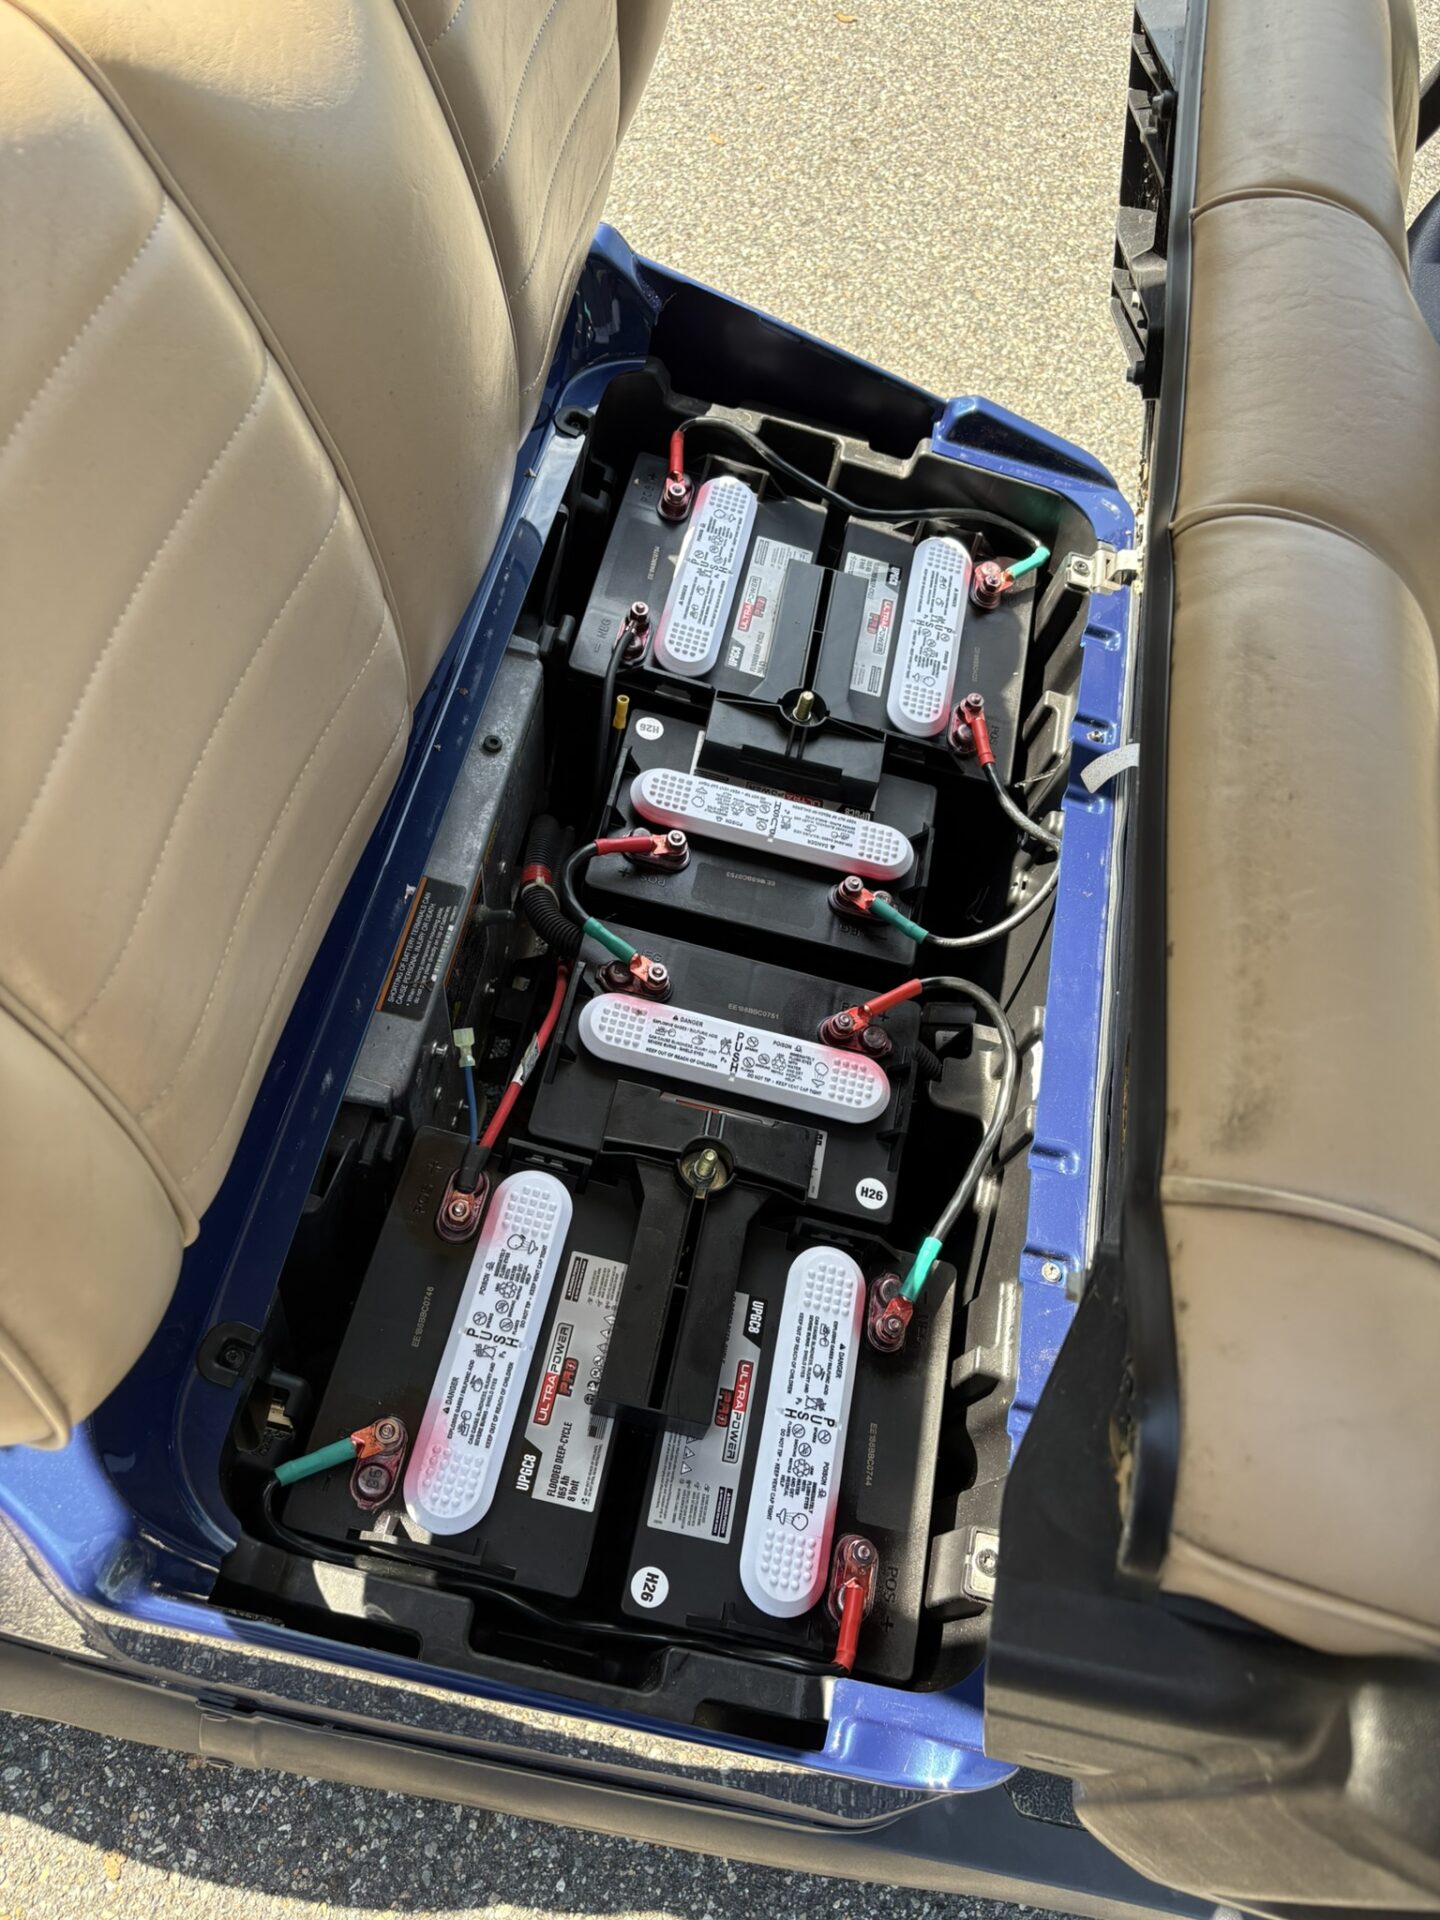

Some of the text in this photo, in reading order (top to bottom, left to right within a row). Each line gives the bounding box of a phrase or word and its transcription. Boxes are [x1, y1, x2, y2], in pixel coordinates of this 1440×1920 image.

[689, 557, 728, 574] PUSH
[915, 618, 953, 633] PUSH
[639, 722, 659, 734] H26
[768, 800, 781, 835] PUSH
[395, 901, 436, 1005] CAUSE PERSONAL INJURY OR DEATH
[679, 1015, 704, 1027] DANGER
[729, 1030, 745, 1073] PUSH
[859, 1185, 884, 1201] H26
[477, 1271, 490, 1295] POISON
[518, 1243, 548, 1328] DO NOT TIP KEEP VENT CAP TIGHT
[746, 1299, 765, 1334] UPGC8
[465, 1324, 520, 1350] PUSH
[794, 1336, 801, 1344] OF
[790, 1360, 797, 1369] OF
[791, 1343, 799, 1361] REACH
[834, 1351, 845, 1379] DANGER
[536, 1325, 570, 1422] ULTRAPOWER
[558, 1358, 579, 1394] PRO
[786, 1368, 795, 1394] CHILDREN
[444, 1375, 459, 1406] DANGER
[483, 1360, 514, 1449] KEEP OUT OF REACH OF CHILDREN
[725, 1362, 752, 1460] ULTRAPOWER
[783, 1407, 836, 1428] PUSH
[514, 1451, 538, 1492] UPGC8
[544, 1420, 573, 1497] FLOODED DEEP-CYCLE
[555, 1473, 570, 1499] 165 Ah
[766, 1427, 786, 1521] DO NOT TIP KEEP VENT CAP TIGHT
[820, 1461, 830, 1486] POISON
[566, 1478, 580, 1502] 8 Volt
[639, 1571, 659, 1603] H26
[882, 1565, 899, 1604] POS
